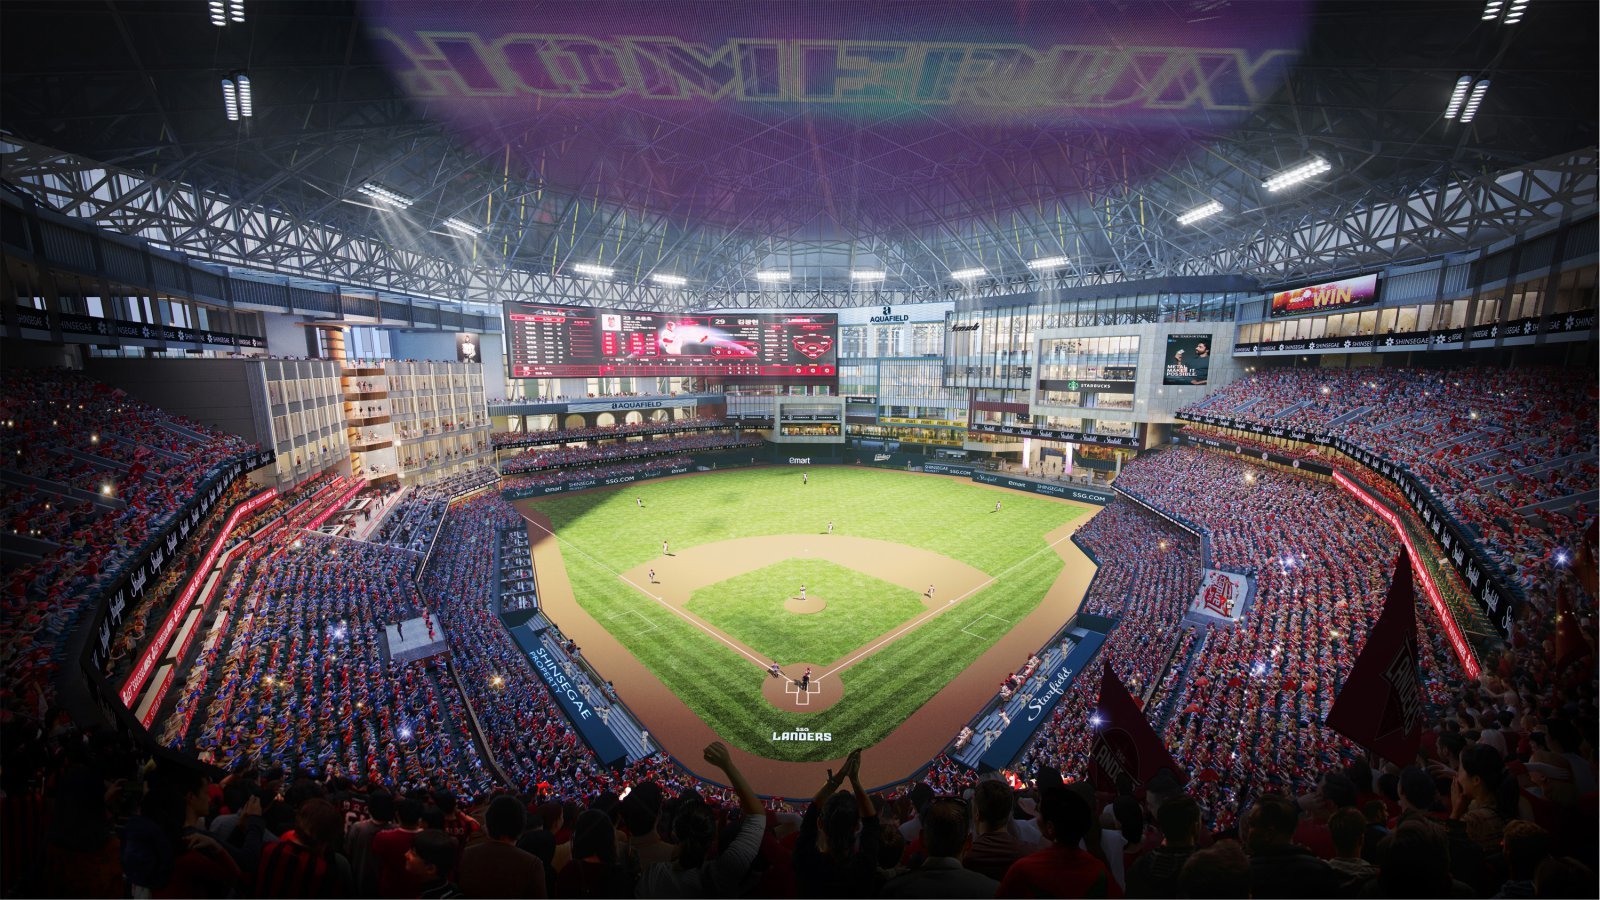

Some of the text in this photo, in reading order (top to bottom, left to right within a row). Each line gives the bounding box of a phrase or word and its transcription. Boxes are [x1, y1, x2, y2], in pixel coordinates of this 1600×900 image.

[1313, 288, 1352, 307] WIN
[870, 315, 909, 323] AQUAFIELD
[1315, 341, 1340, 349] SHINSEGAE
[789, 457, 811, 465] emart
[671, 467, 687, 475] emart
[605, 476, 635, 485] SSG.COM
[1008, 480, 1026, 488] emart
[545, 485, 562, 493] emart
[1037, 483, 1064, 493] SHINSEGAE
[1072, 491, 1106, 502] SSG.COM
[529, 651, 563, 694] PROPERTY
[536, 647, 592, 720] SHINSEGAE
[1028, 667, 1073, 722] Starfield
[772, 732, 832, 741] LANDERS
